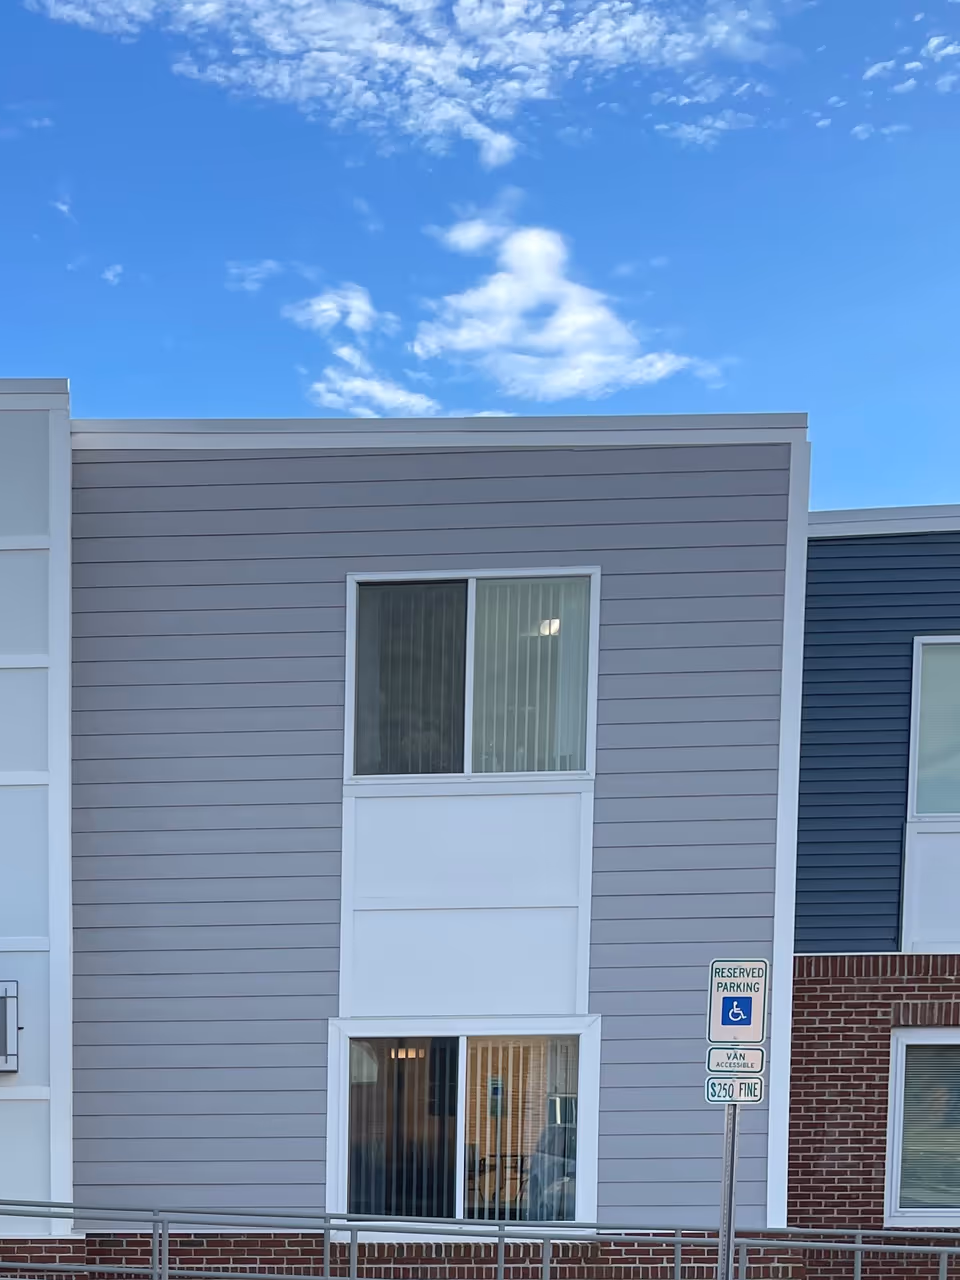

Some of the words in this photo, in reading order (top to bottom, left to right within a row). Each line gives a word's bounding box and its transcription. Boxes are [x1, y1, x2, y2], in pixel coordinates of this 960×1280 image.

[714, 967, 764, 978] RESERVED
[716, 981, 760, 993] PARKING
[726, 1052, 746, 1061] VAN
[715, 1061, 755, 1069] ACCESSIBLE
[710, 1081, 734, 1098] $250
[738, 1082, 759, 1098] FINE
